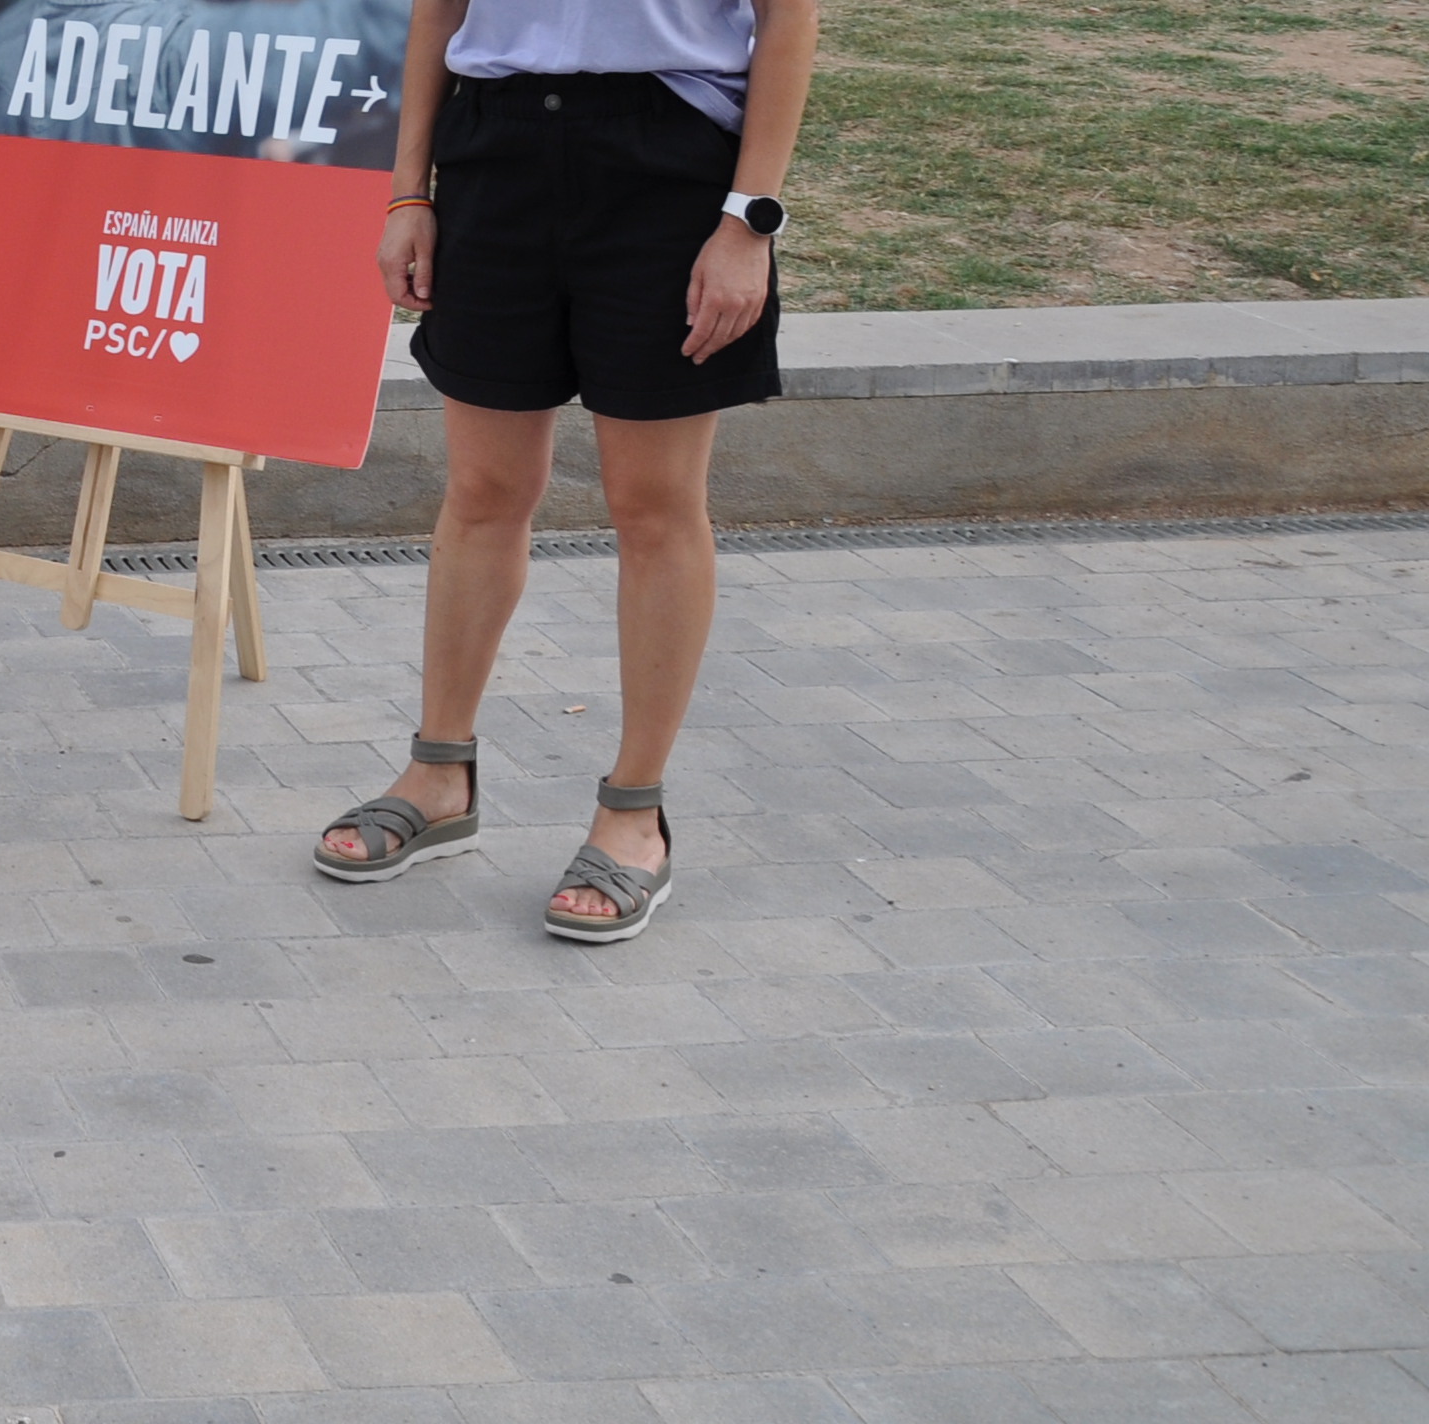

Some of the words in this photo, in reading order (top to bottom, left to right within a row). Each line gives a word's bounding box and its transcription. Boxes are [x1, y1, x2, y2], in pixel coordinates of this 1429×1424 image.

[6, 17, 360, 145] ADELANTE
[102, 210, 159, 240] ESPAÑA
[161, 216, 219, 247] AVANZA
[95, 244, 207, 324] VOTA
